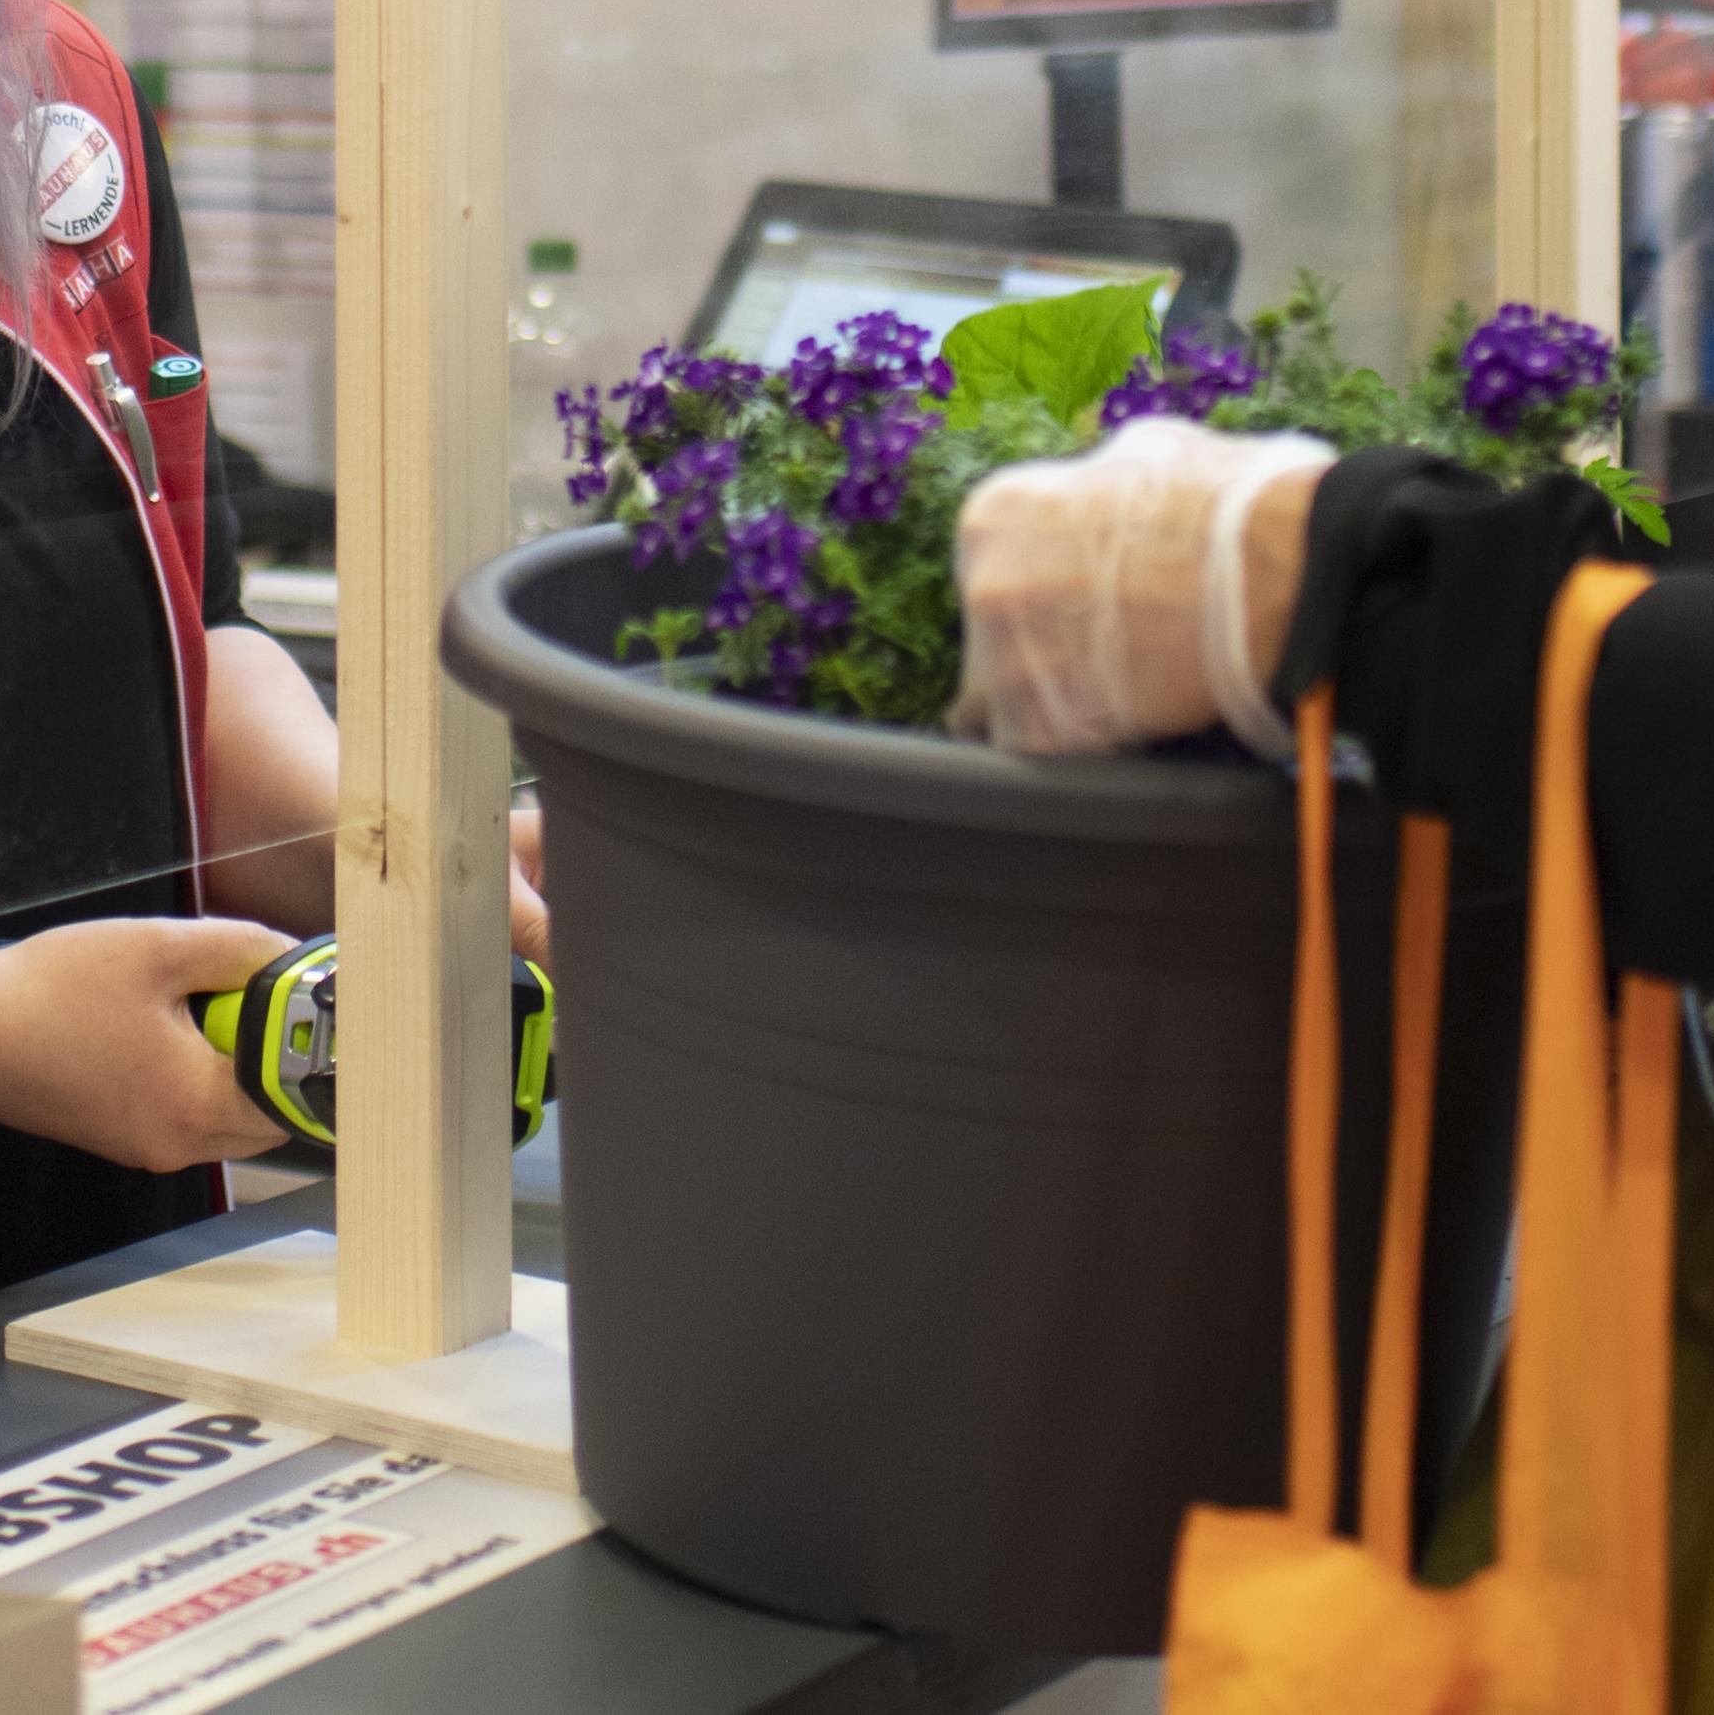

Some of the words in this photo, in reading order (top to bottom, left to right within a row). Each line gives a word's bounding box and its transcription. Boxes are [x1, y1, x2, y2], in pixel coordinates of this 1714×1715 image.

[39, 128, 108, 210] AUHAUS
[64, 177, 119, 236] LERNENDE
[311, 1476, 395, 1503] Sie
